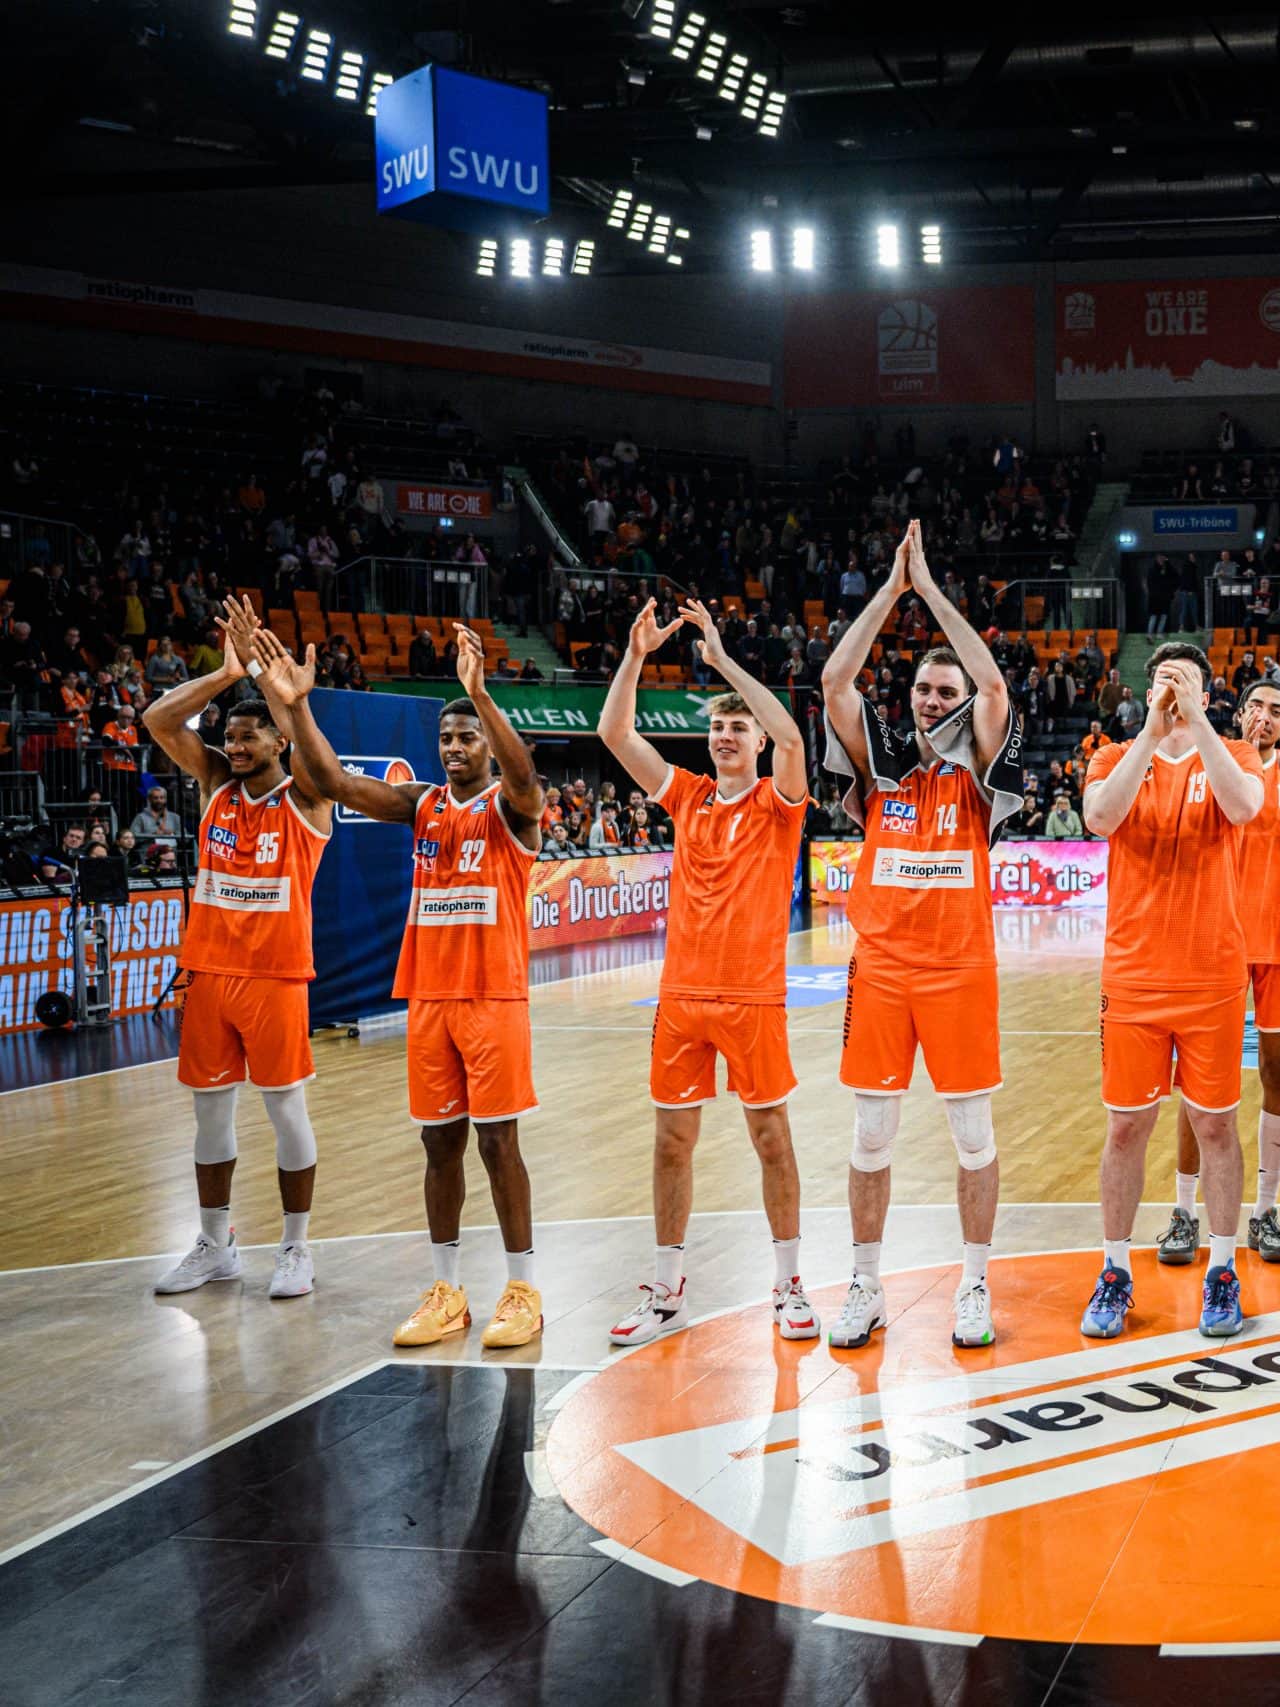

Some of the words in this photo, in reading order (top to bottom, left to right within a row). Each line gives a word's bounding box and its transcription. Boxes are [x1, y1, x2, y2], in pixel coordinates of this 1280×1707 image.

[383, 144, 428, 193] SWU
[449, 147, 538, 194] SWU
[87, 281, 195, 307] ratiopharm
[1145, 291, 1173, 307] WE
[1175, 290, 1208, 306] ARE
[1145, 306, 1208, 336] ONE
[408, 490, 425, 511] WE
[1159, 516, 1233, 529] SWU-Tribüne
[885, 801, 916, 819] LIQUI
[937, 803, 958, 836] 14
[881, 816, 915, 833] MOLY
[255, 831, 280, 864] 35
[458, 839, 486, 873] 32
[899, 863, 962, 878] ratiopharm
[1054, 860, 1093, 892] die
[220, 886, 280, 902] ratiopharm
[423, 900, 486, 914] ratiopharm
[531, 891, 560, 930] Die
[568, 865, 670, 924] Druckerei
